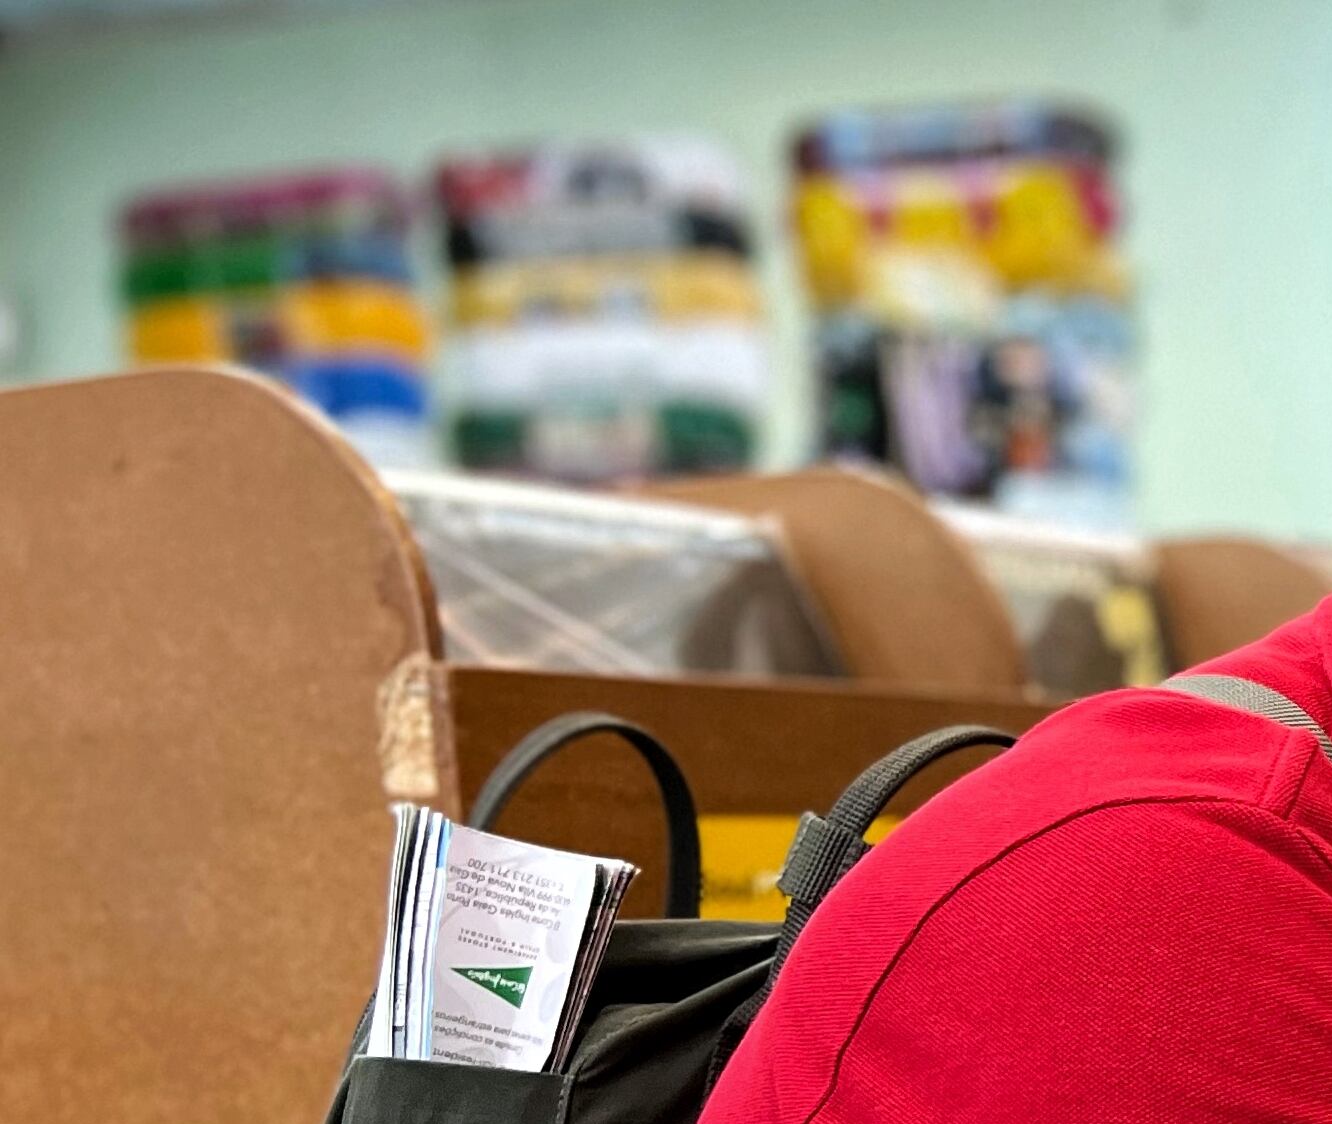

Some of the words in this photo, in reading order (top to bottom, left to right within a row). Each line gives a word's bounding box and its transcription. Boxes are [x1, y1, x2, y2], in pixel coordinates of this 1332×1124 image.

[467, 857, 488, 871] 700
[490, 865, 512, 877] 711
[471, 871, 486, 883] de
[512, 871, 534, 884] 213
[455, 881, 479, 896] 1435
[487, 876, 517, 893] Nova
[446, 892, 471, 908] Porto
